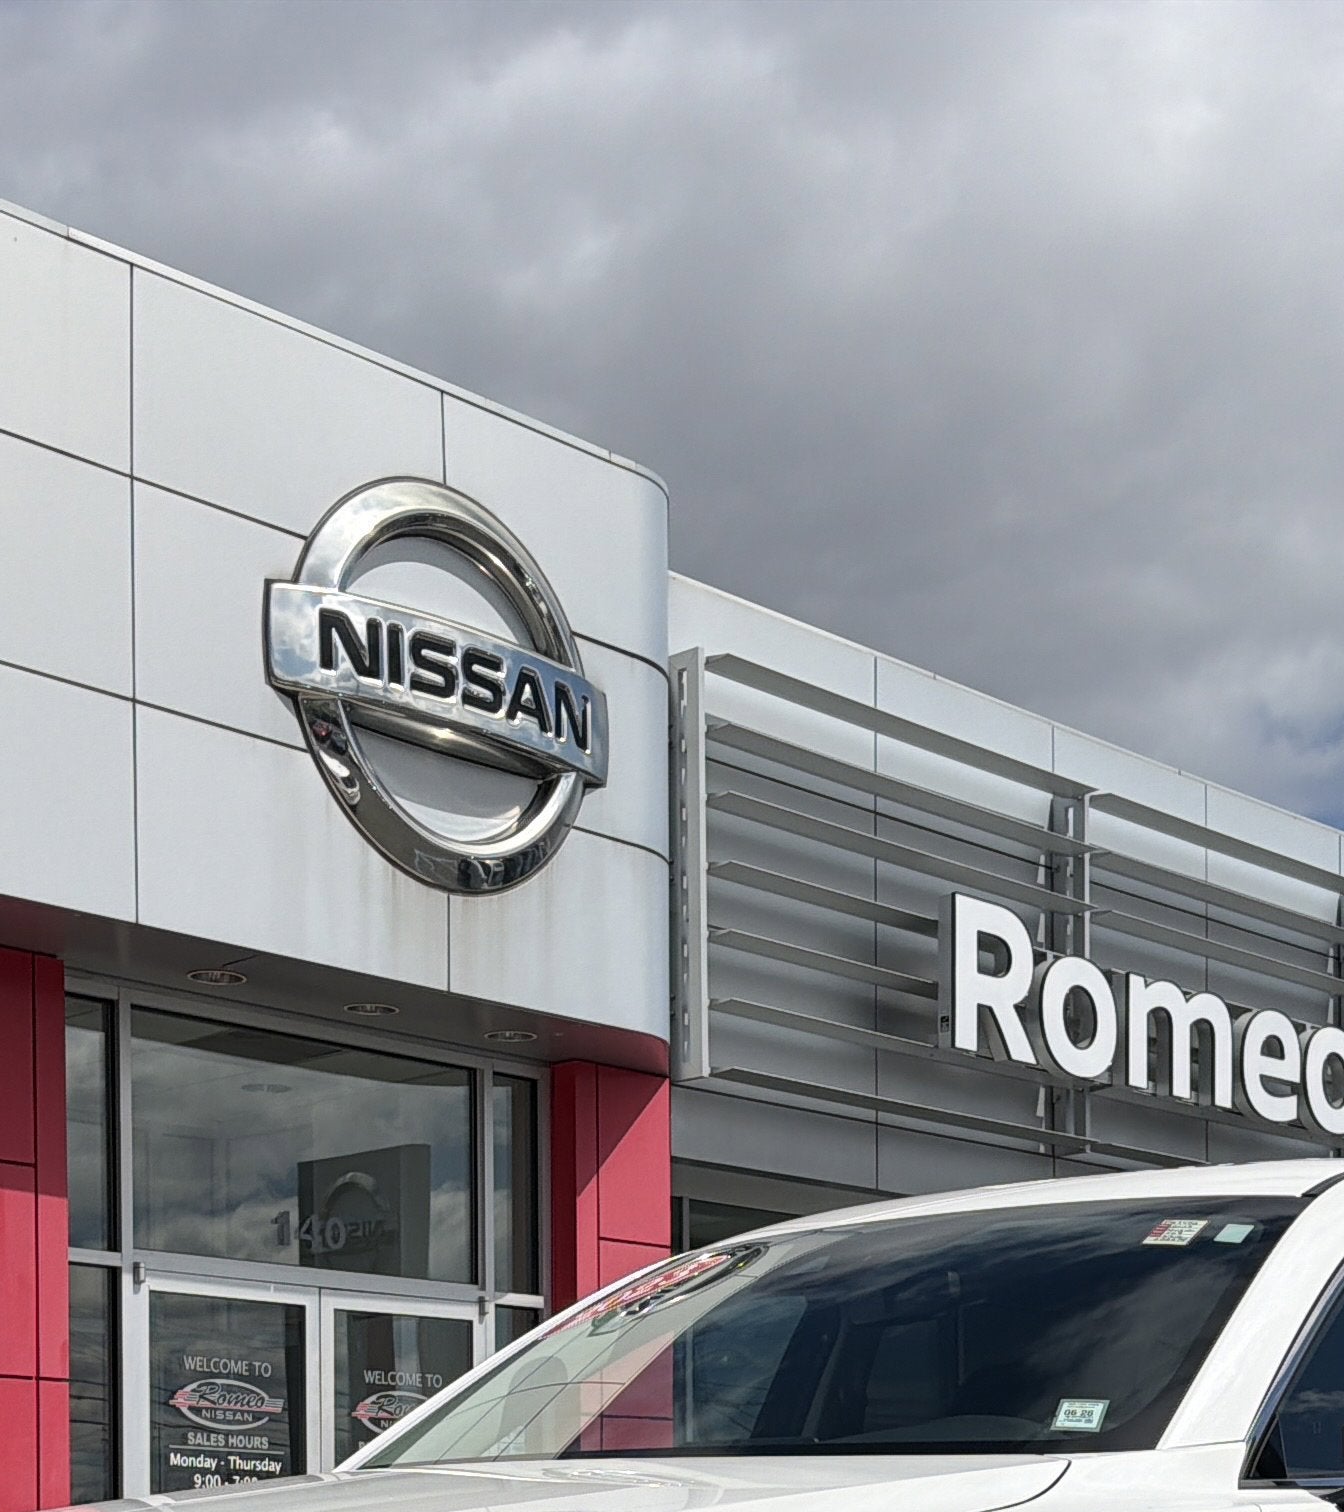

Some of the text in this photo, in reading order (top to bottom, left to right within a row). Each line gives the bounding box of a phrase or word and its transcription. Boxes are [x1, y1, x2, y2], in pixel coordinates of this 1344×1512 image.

[318, 607, 592, 756] NISSAN
[270, 1209, 347, 1253] 140
[183, 1354, 272, 1378] WELCOME TO
[363, 1369, 443, 1388] WELCOME TO
[195, 1381, 266, 1408] Romeo
[201, 1408, 253, 1421] NISSAN
[187, 1431, 269, 1449] SALES HOURS
[169, 1452, 218, 1471] Monday
[227, 1455, 282, 1475] Thursday
[193, 1473, 222, 1489] 9:00
